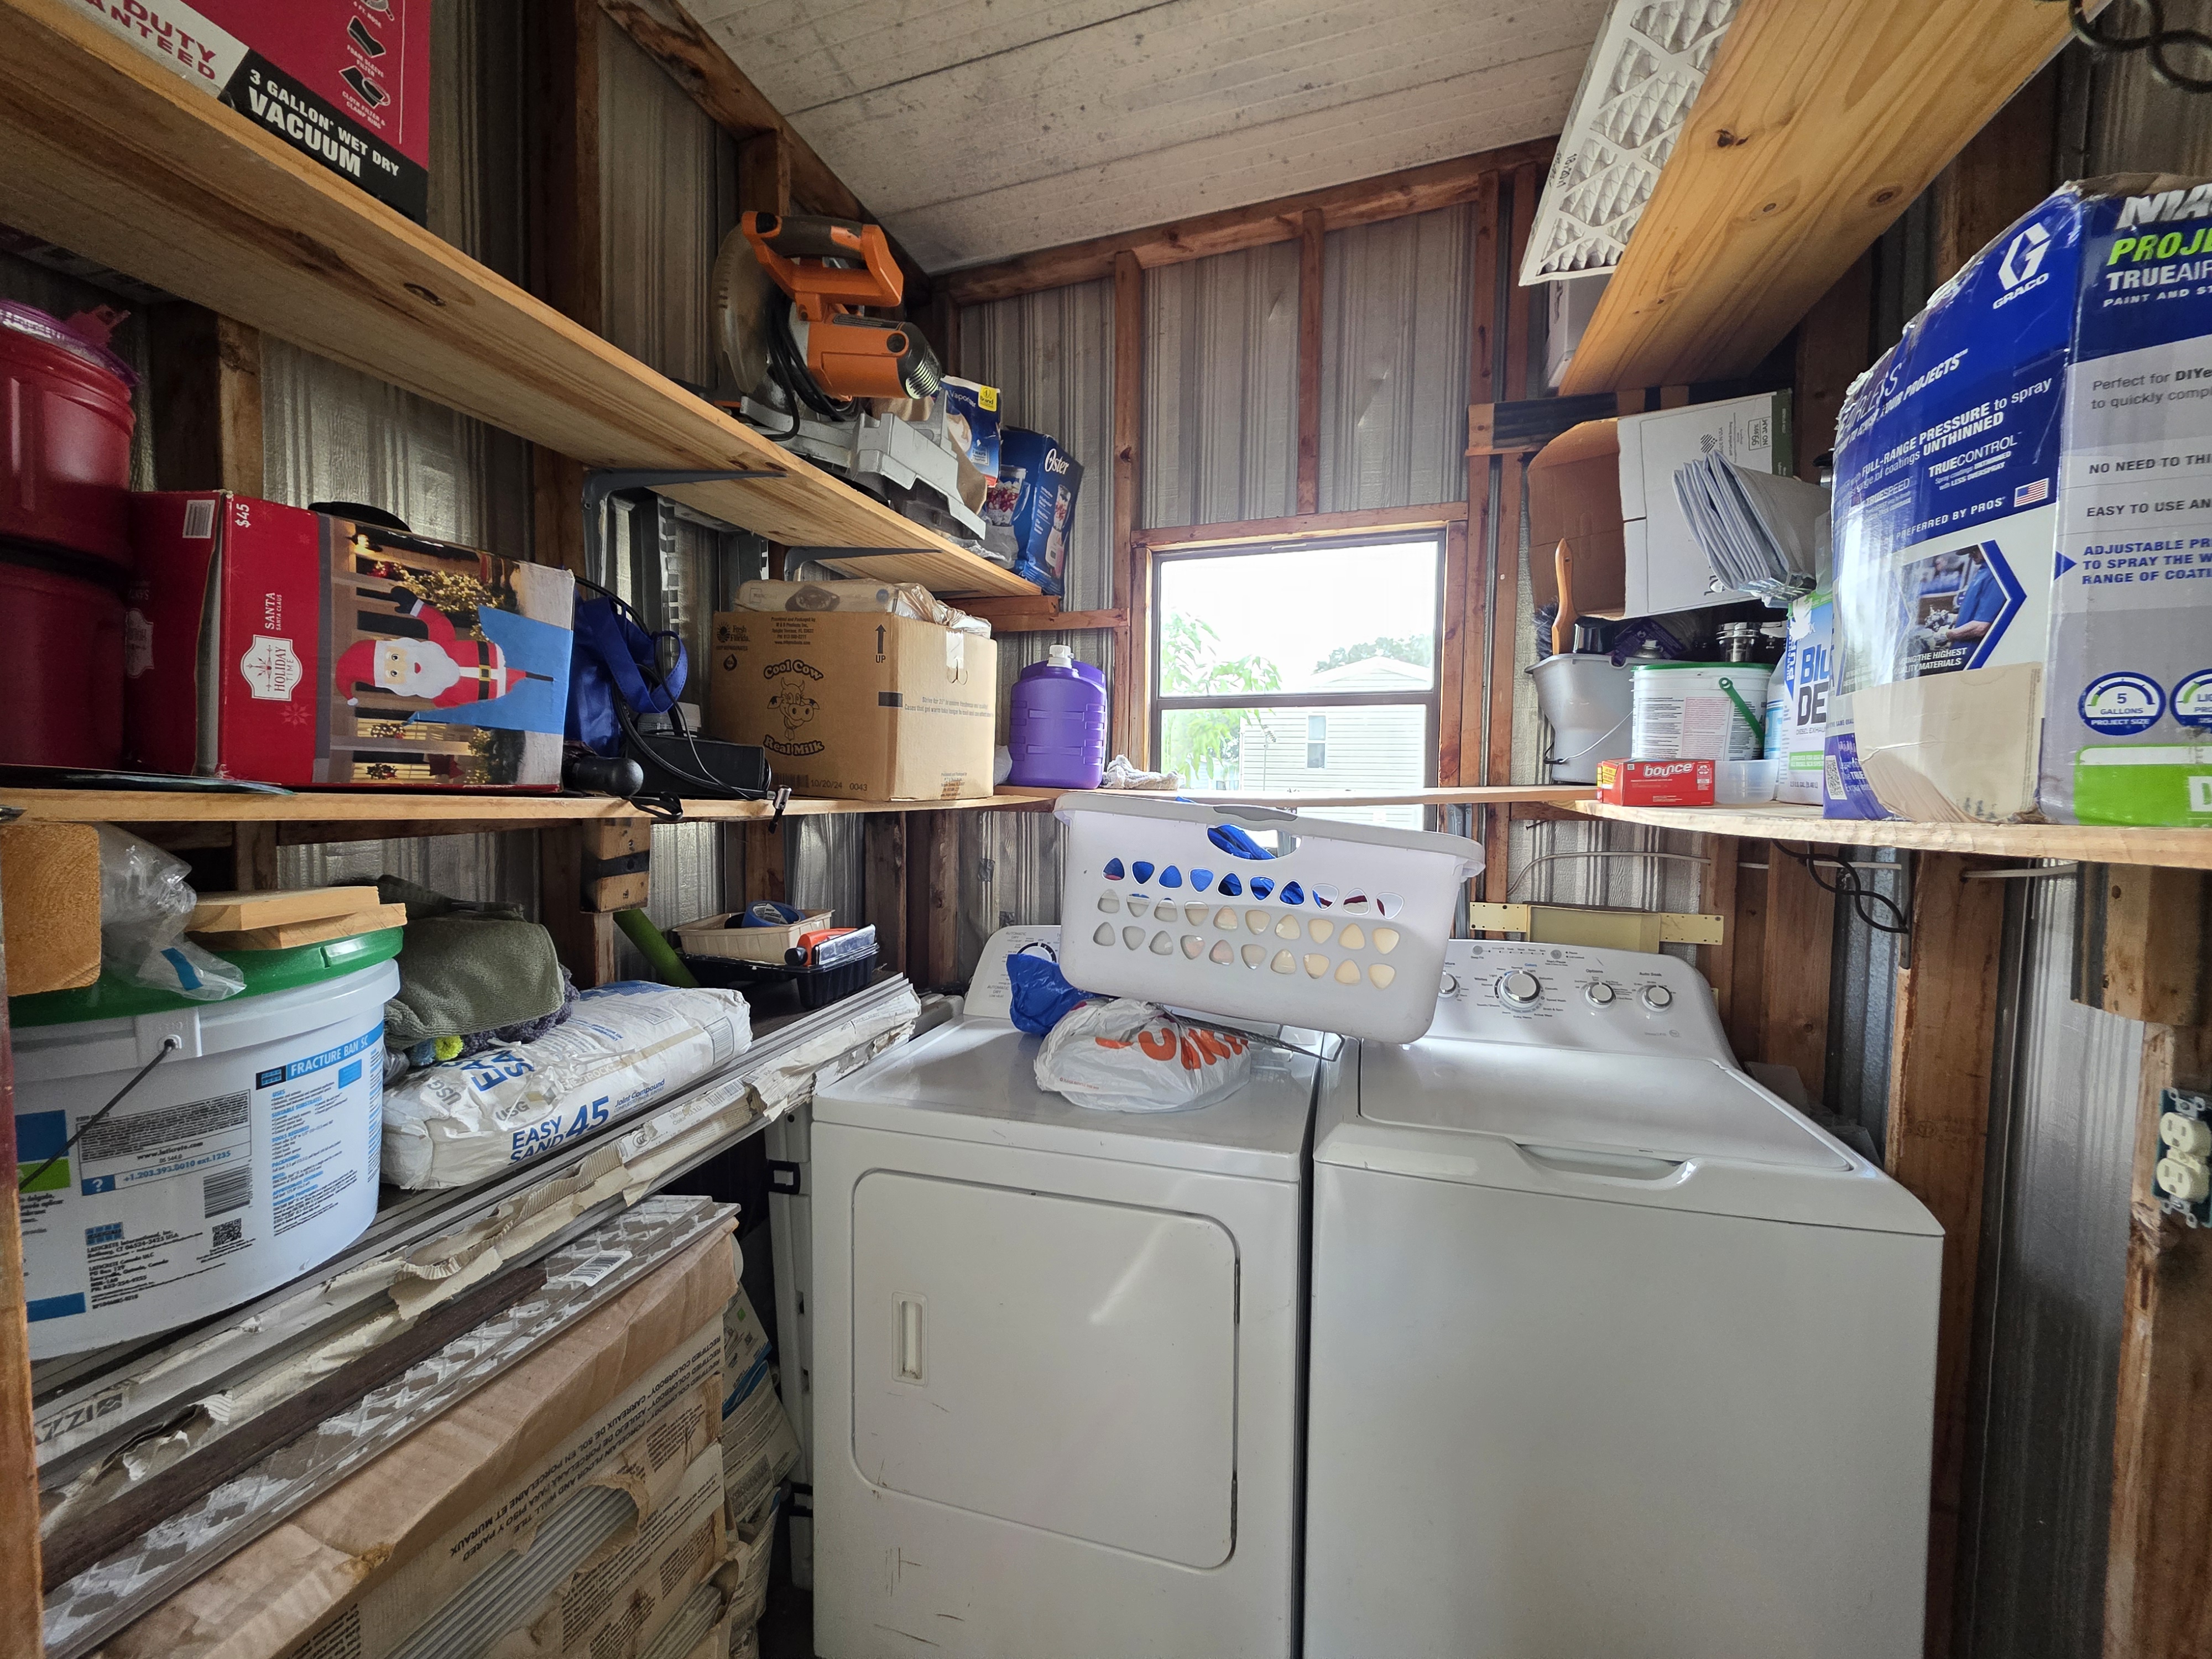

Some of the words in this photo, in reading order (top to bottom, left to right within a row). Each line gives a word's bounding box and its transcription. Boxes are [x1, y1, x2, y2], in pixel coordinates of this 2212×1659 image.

[123, 0, 216, 63] DUTY
[357, 59, 375, 77] FILTER
[364, 59, 384, 77] SLEEVE
[342, 91, 360, 107] CLOTH
[361, 104, 380, 121] FILTER
[249, 69, 260, 85] 3
[338, 127, 368, 155] WET
[372, 150, 399, 176] DRY
[249, 86, 361, 178] VACUUM
[367, 116, 381, 129] RING
[1992, 273, 2049, 310] GRACO
[2103, 294, 2151, 307] PAINT
[2156, 288, 2190, 300] AND
[2093, 373, 2146, 391] Perfect
[2150, 373, 2171, 384] for
[979, 395, 994, 405] Brand
[2090, 400, 2106, 410] to
[2110, 390, 2163, 409] quickly
[1861, 436, 1917, 478] FULL-RANGE
[1919, 401, 1991, 446] PRESSURE
[1994, 398, 2008, 411] to
[2011, 378, 2052, 404] spray
[1762, 435, 1768, 446] NO
[1884, 450, 1921, 476] coatings
[1923, 411, 2005, 457] UNTHINNED
[1044, 448, 1070, 475] Oster
[2089, 463, 2110, 474] NO
[2115, 458, 2156, 472] NEED
[2159, 456, 2180, 468] TO
[1934, 476, 1950, 484] Spray
[1951, 475, 1967, 487] LESS
[234, 503, 250, 528] $45
[2086, 505, 2125, 517] EASY
[2130, 503, 2149, 514] TO
[2154, 500, 2185, 512] USE
[1896, 514, 1949, 541] PREFERRED
[1952, 508, 1967, 520] BY
[2083, 539, 2184, 556] ADJUSTABLE
[2083, 559, 2102, 570] TO
[2107, 556, 2158, 569] SPRAY
[2163, 554, 2194, 565] THE
[2081, 572, 2134, 585] RANGE
[2138, 570, 2159, 581] OF
[265, 592, 276, 630] SANTA
[732, 624, 747, 633] Fresh
[875, 655, 886, 664] UP
[1917, 652, 1931, 661] THE
[1933, 647, 1968, 659] HIGHEST
[1918, 658, 1963, 671] MATERIALS
[274, 646, 286, 692] HOLIDAY
[286, 658, 294, 681] TIME
[763, 659, 792, 680] Cool
[792, 659, 824, 681] Cow
[904, 703, 916, 712] Cases
[2116, 693, 2127, 704] 5
[763, 734, 792, 755] Real
[792, 739, 825, 756] Milk
[1644, 761, 1694, 778] bounce
[811, 779, 843, 789] 10/20/24
[849, 783, 868, 791] 0043
[290, 1047, 342, 1077] FRACTURE
[343, 1041, 359, 1057] BAN
[360, 1035, 369, 1048] SC
[272, 1089, 286, 1097] USES
[427, 1077, 462, 1107] USG
[614, 1094, 631, 1108] Joint
[631, 1078, 665, 1098] Compound
[272, 1105, 295, 1118] SUITABLE
[295, 1095, 323, 1110] SUBSTRATES
[565, 1095, 609, 1139] 45
[512, 1115, 562, 1150] EASY
[137, 1142, 204, 1160] www.laticrete.com
[507, 1134, 564, 1166] SAND
[123, 1160, 196, 1182] +1.203.393.0010
[196, 1150, 232, 1166] ext.1235
[691, 1335, 721, 1363] RECTIFIED
[691, 1347, 721, 1375] RECTIFIED
[691, 1358, 721, 1386] RECTIFIED
[607, 1395, 646, 1428] CARREAUX
[614, 1407, 646, 1437] AZULEJO
[579, 1436, 594, 1452] SOL
[594, 1428, 606, 1440] DE
[603, 1434, 613, 1447] DE
[604, 1420, 646, 1458] PORCELAIN
[551, 1446, 602, 1486] PORCELANA
[564, 1451, 577, 1464] EN
[577, 1455, 604, 1481] FLOOR
[509, 1462, 564, 1509] PORCELAINE
[528, 1482, 551, 1507] PARA
[557, 1479, 576, 1496] AND
[495, 1504, 508, 1521] ET
[534, 1493, 557, 1515] WALL
[505, 1506, 528, 1527] PISO
[513, 1515, 534, 1535] TILE
[450, 1516, 494, 1557] MURAUX
[462, 1529, 497, 1562] PARED
